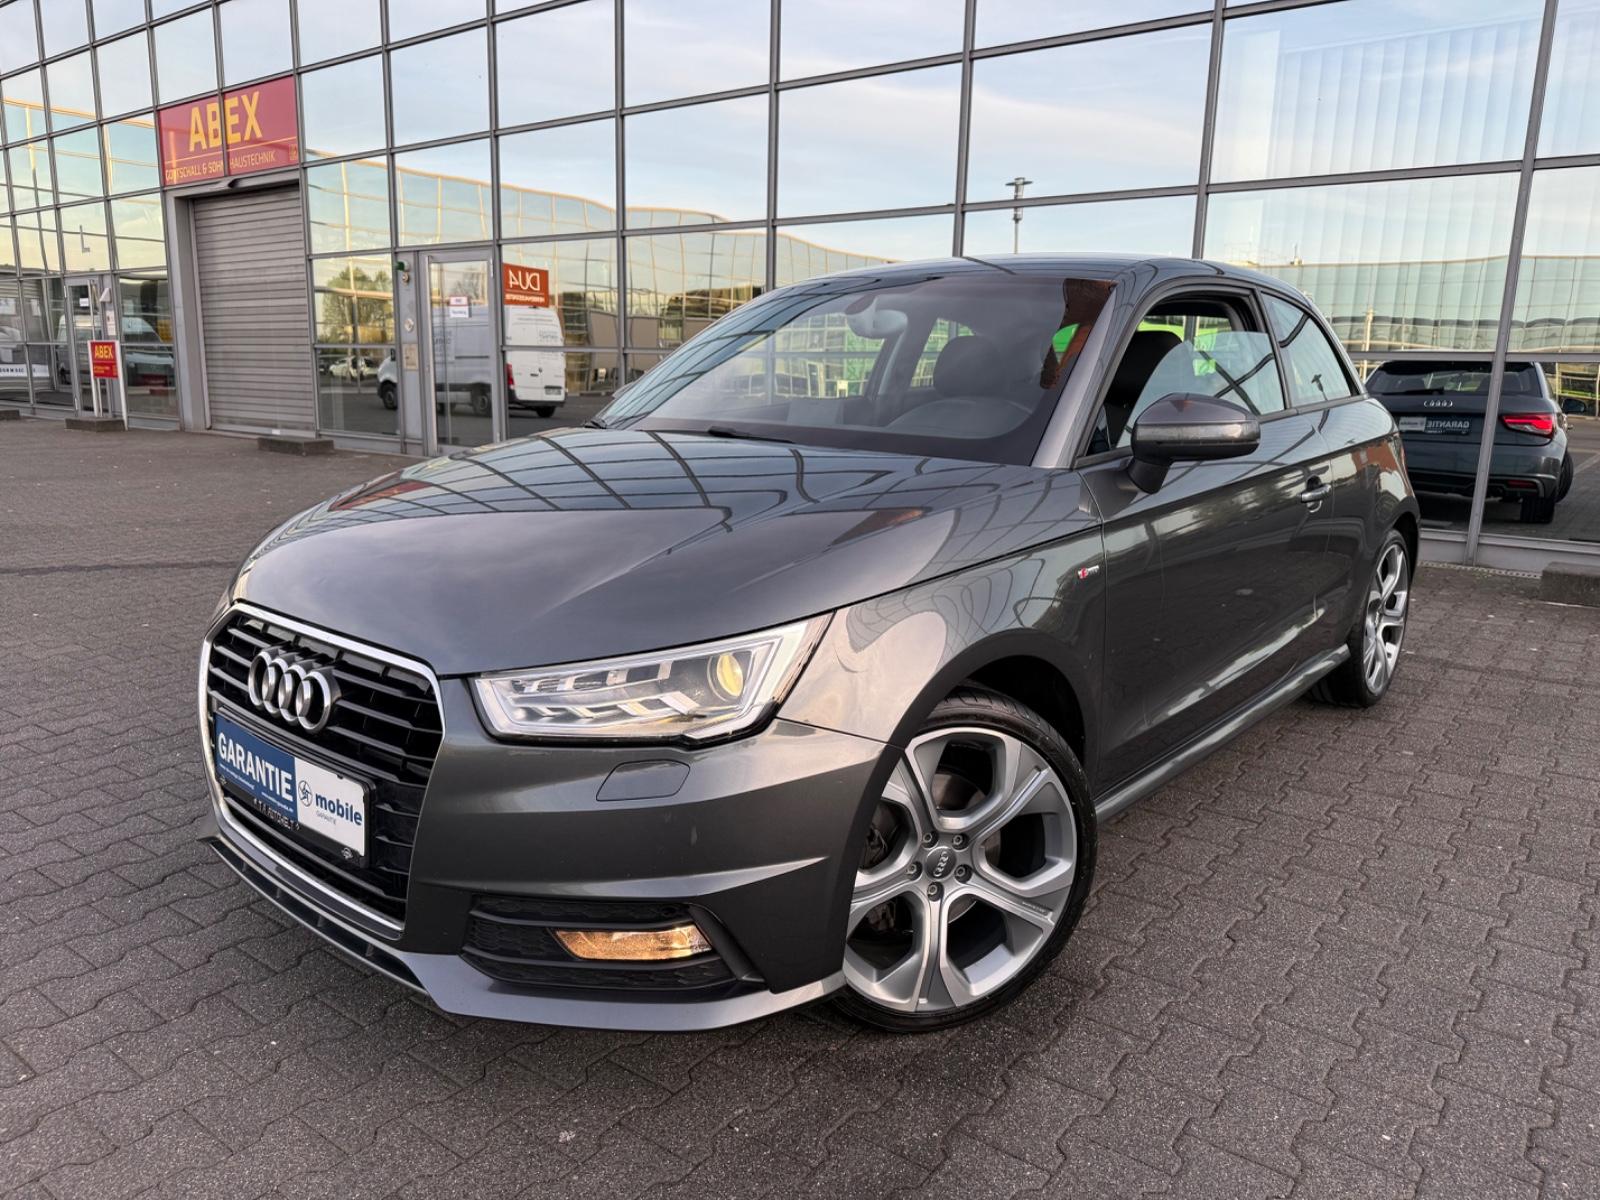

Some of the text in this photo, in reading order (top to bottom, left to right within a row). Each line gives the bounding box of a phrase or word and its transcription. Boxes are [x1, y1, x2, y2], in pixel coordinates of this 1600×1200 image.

[189, 91, 262, 152] ABEX
[229, 150, 276, 169] HAUSTECHNIK
[94, 344, 114, 359] ABEX
[218, 732, 294, 802] GARANTIE
[315, 792, 363, 826] mobile
